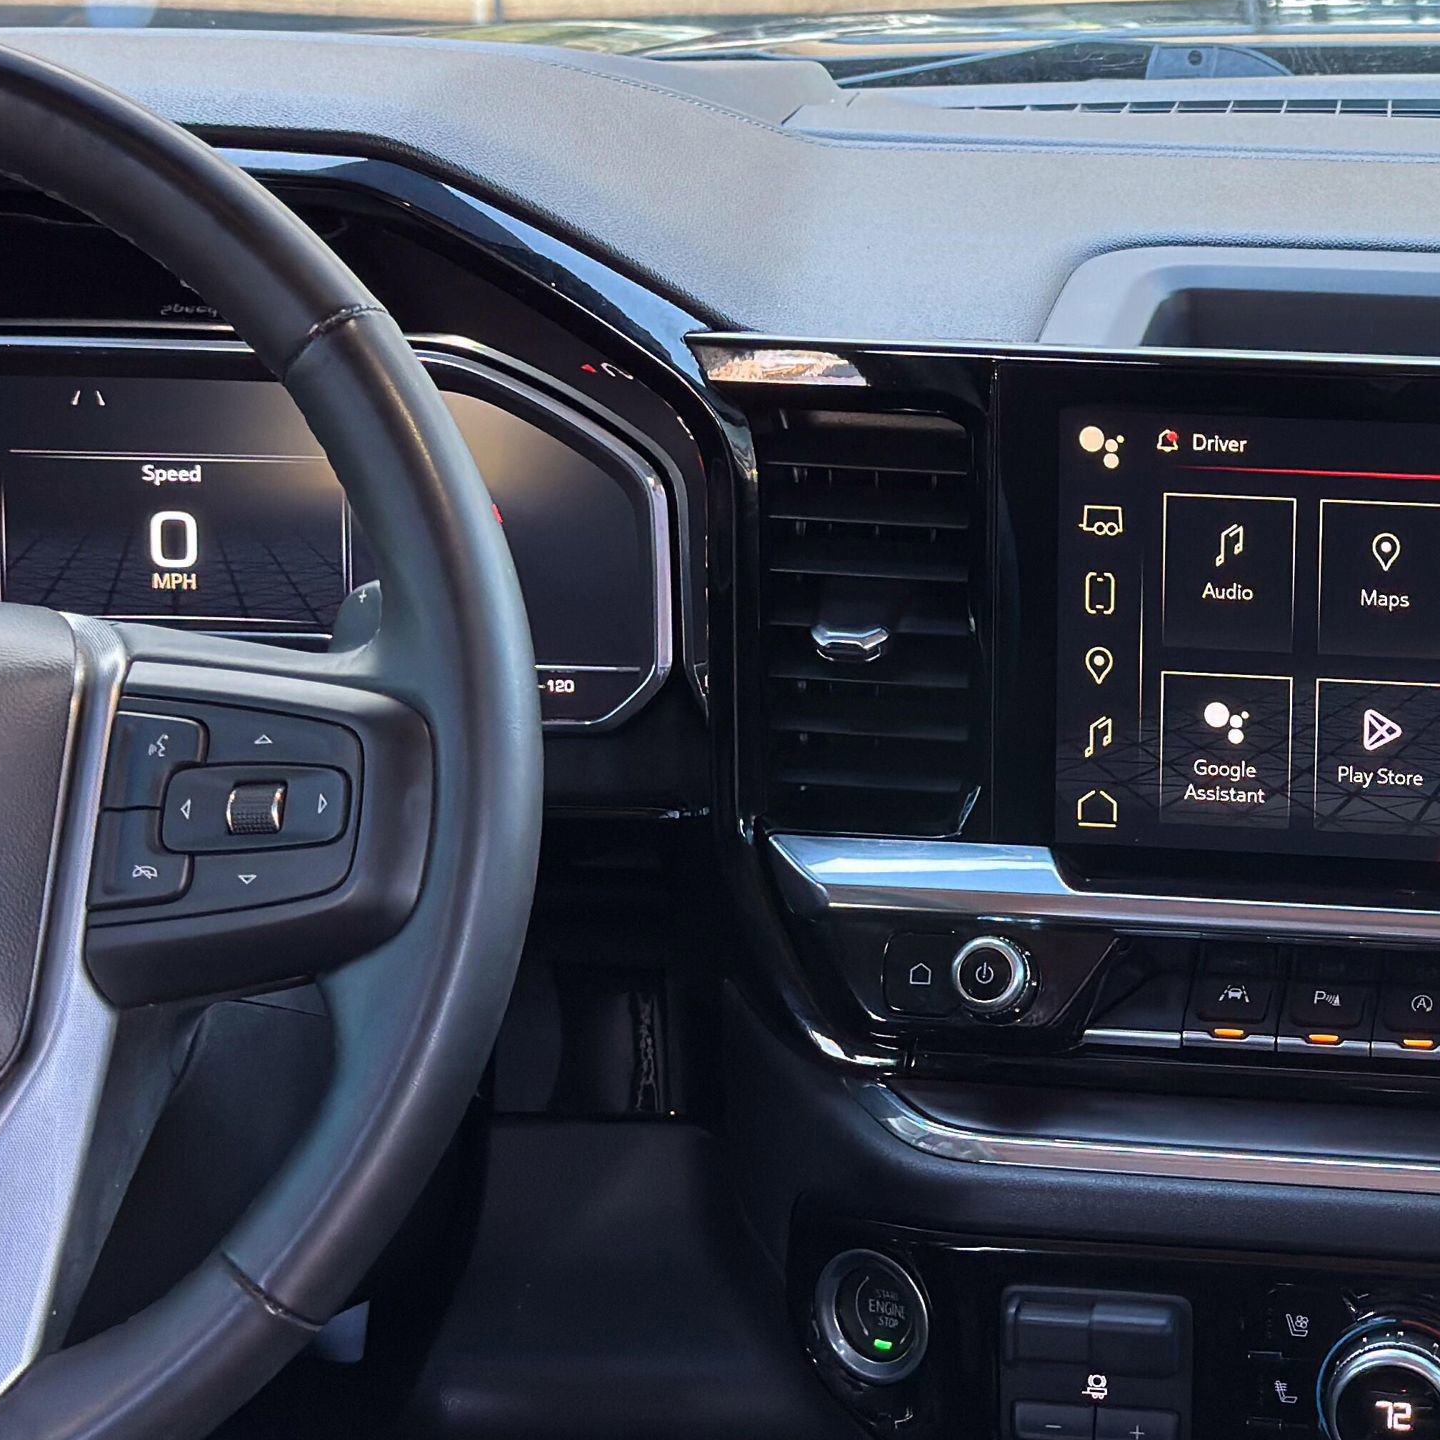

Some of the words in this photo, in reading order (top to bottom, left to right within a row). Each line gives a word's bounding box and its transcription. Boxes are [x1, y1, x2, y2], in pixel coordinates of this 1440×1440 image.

[1192, 433, 1248, 453] Driver
[141, 464, 202, 486] Speed
[150, 510, 198, 569] 0
[151, 572, 197, 590] MPH
[1201, 582, 1254, 601] Audio
[1360, 588, 1410, 612] Maps
[1193, 758, 1257, 782] Google
[1337, 765, 1373, 788] Play
[1377, 767, 1424, 788] Store
[1183, 783, 1265, 804] Assistant
[1375, 1400, 1412, 1432] 72
